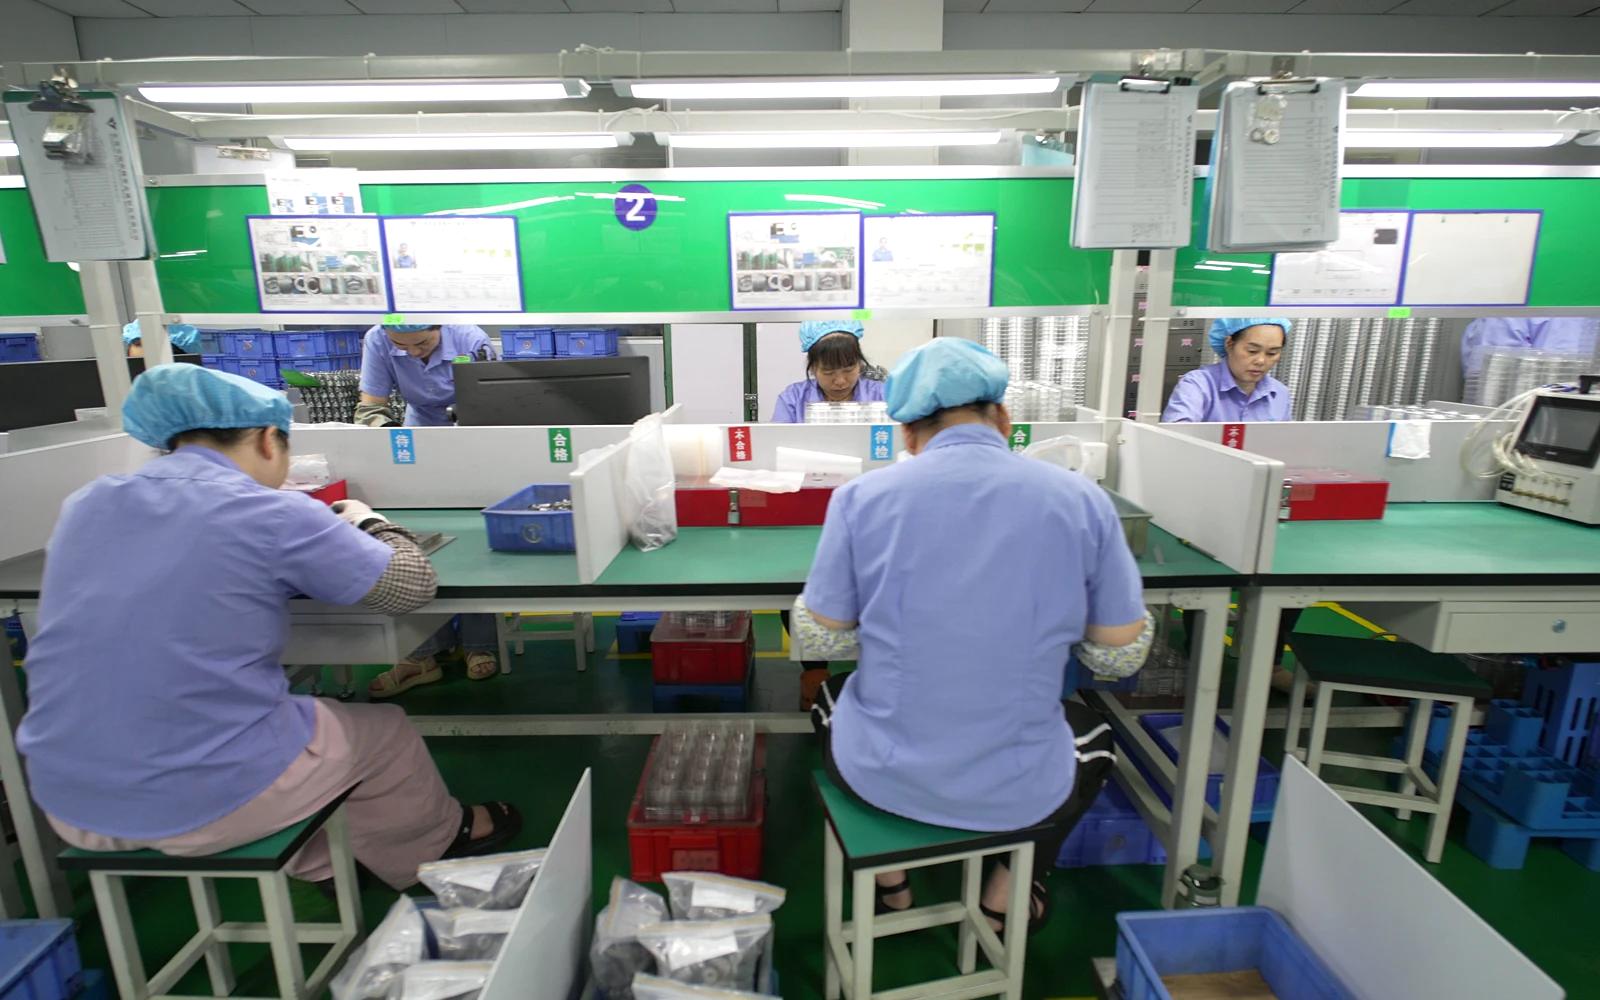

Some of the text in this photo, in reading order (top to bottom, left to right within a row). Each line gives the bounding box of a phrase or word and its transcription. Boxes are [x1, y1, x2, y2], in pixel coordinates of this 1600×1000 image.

[626, 194, 646, 221] 2
[395, 433, 410, 462] 待检
[553, 432, 569, 461] 合格
[734, 430, 746, 460] 不合格
[875, 430, 889, 459] 待检
[1228, 428, 1241, 448] 不合
